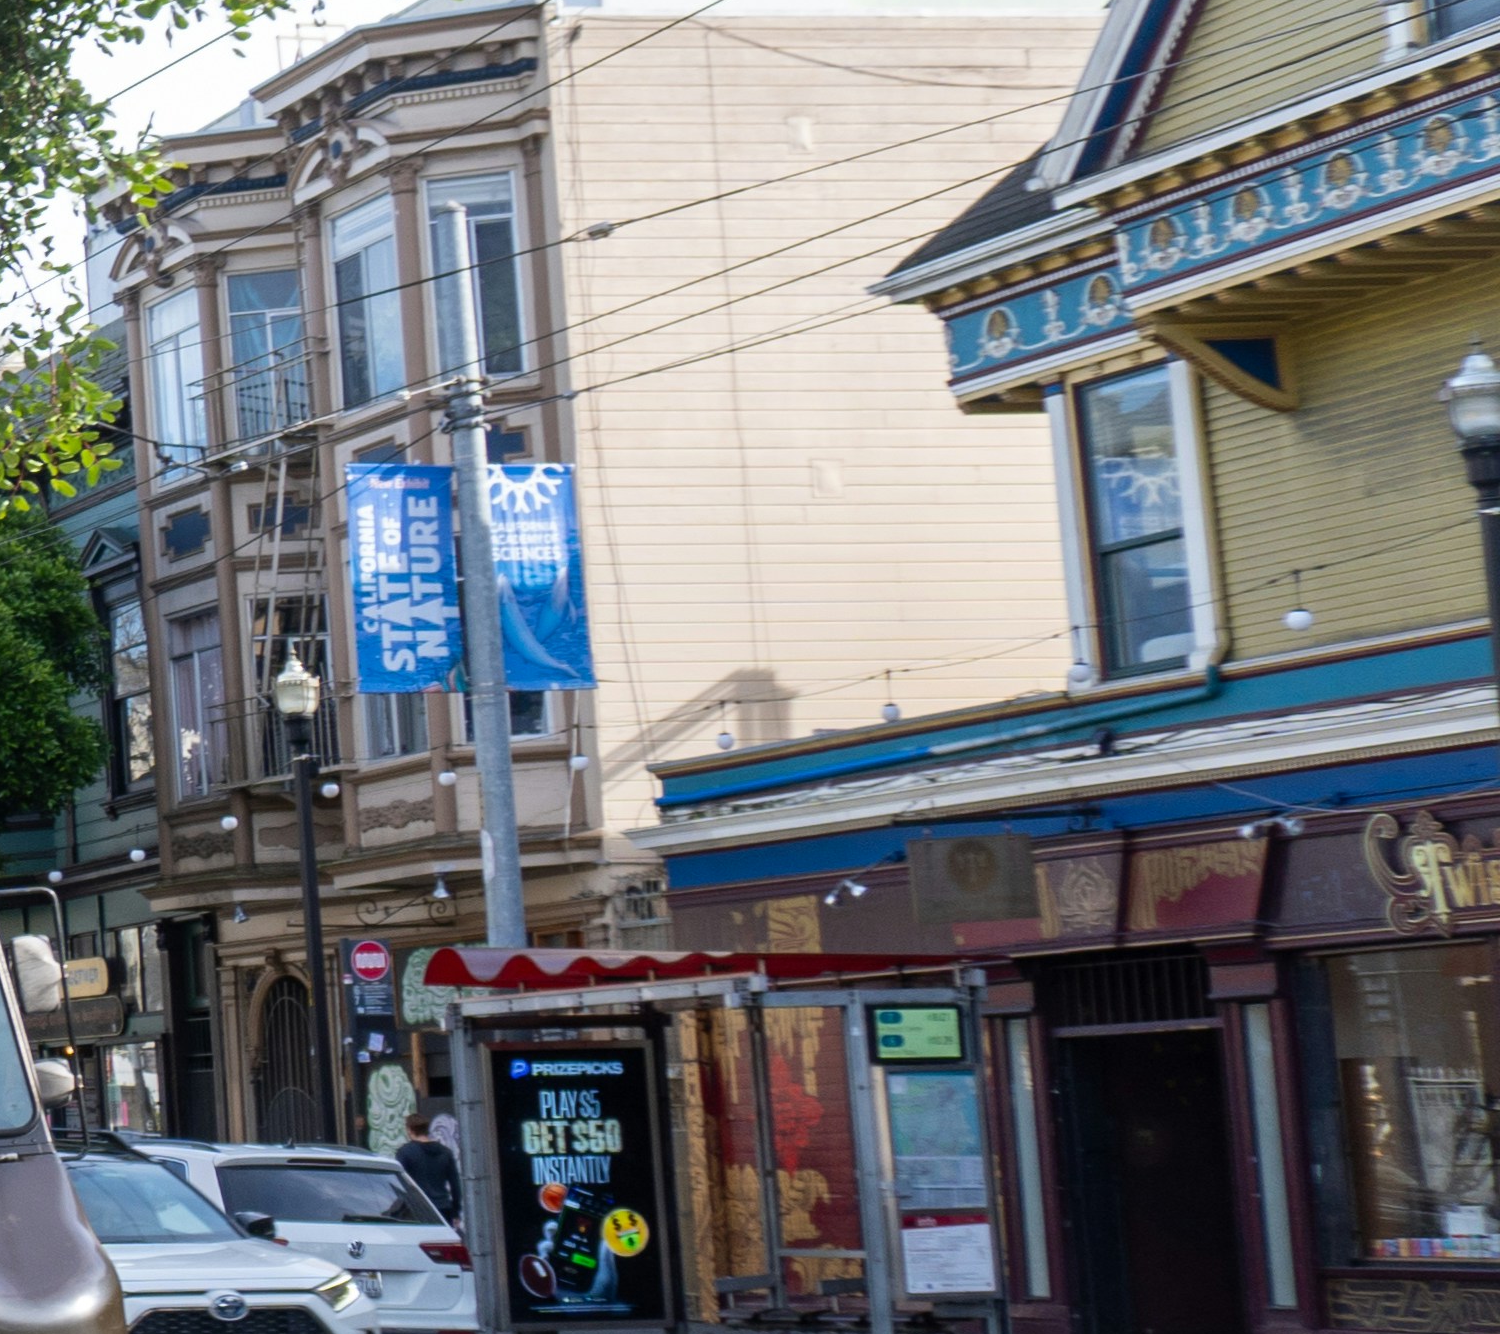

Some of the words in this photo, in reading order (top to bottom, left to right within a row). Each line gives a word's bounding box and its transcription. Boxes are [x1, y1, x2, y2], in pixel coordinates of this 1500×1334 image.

[383, 517, 402, 546] OF
[357, 504, 379, 633] CALIFORNIA
[492, 547, 562, 561] SCIENCES
[407, 495, 451, 657] NATURE
[377, 552, 416, 672] STATE
[531, 1061, 624, 1077] PRIZEPICKS
[538, 1089, 578, 1120] PLAY
[578, 1089, 601, 1118] $5
[521, 1120, 571, 1155] GET
[571, 1118, 623, 1154] $50
[531, 1155, 611, 1186] INSTANTLY
